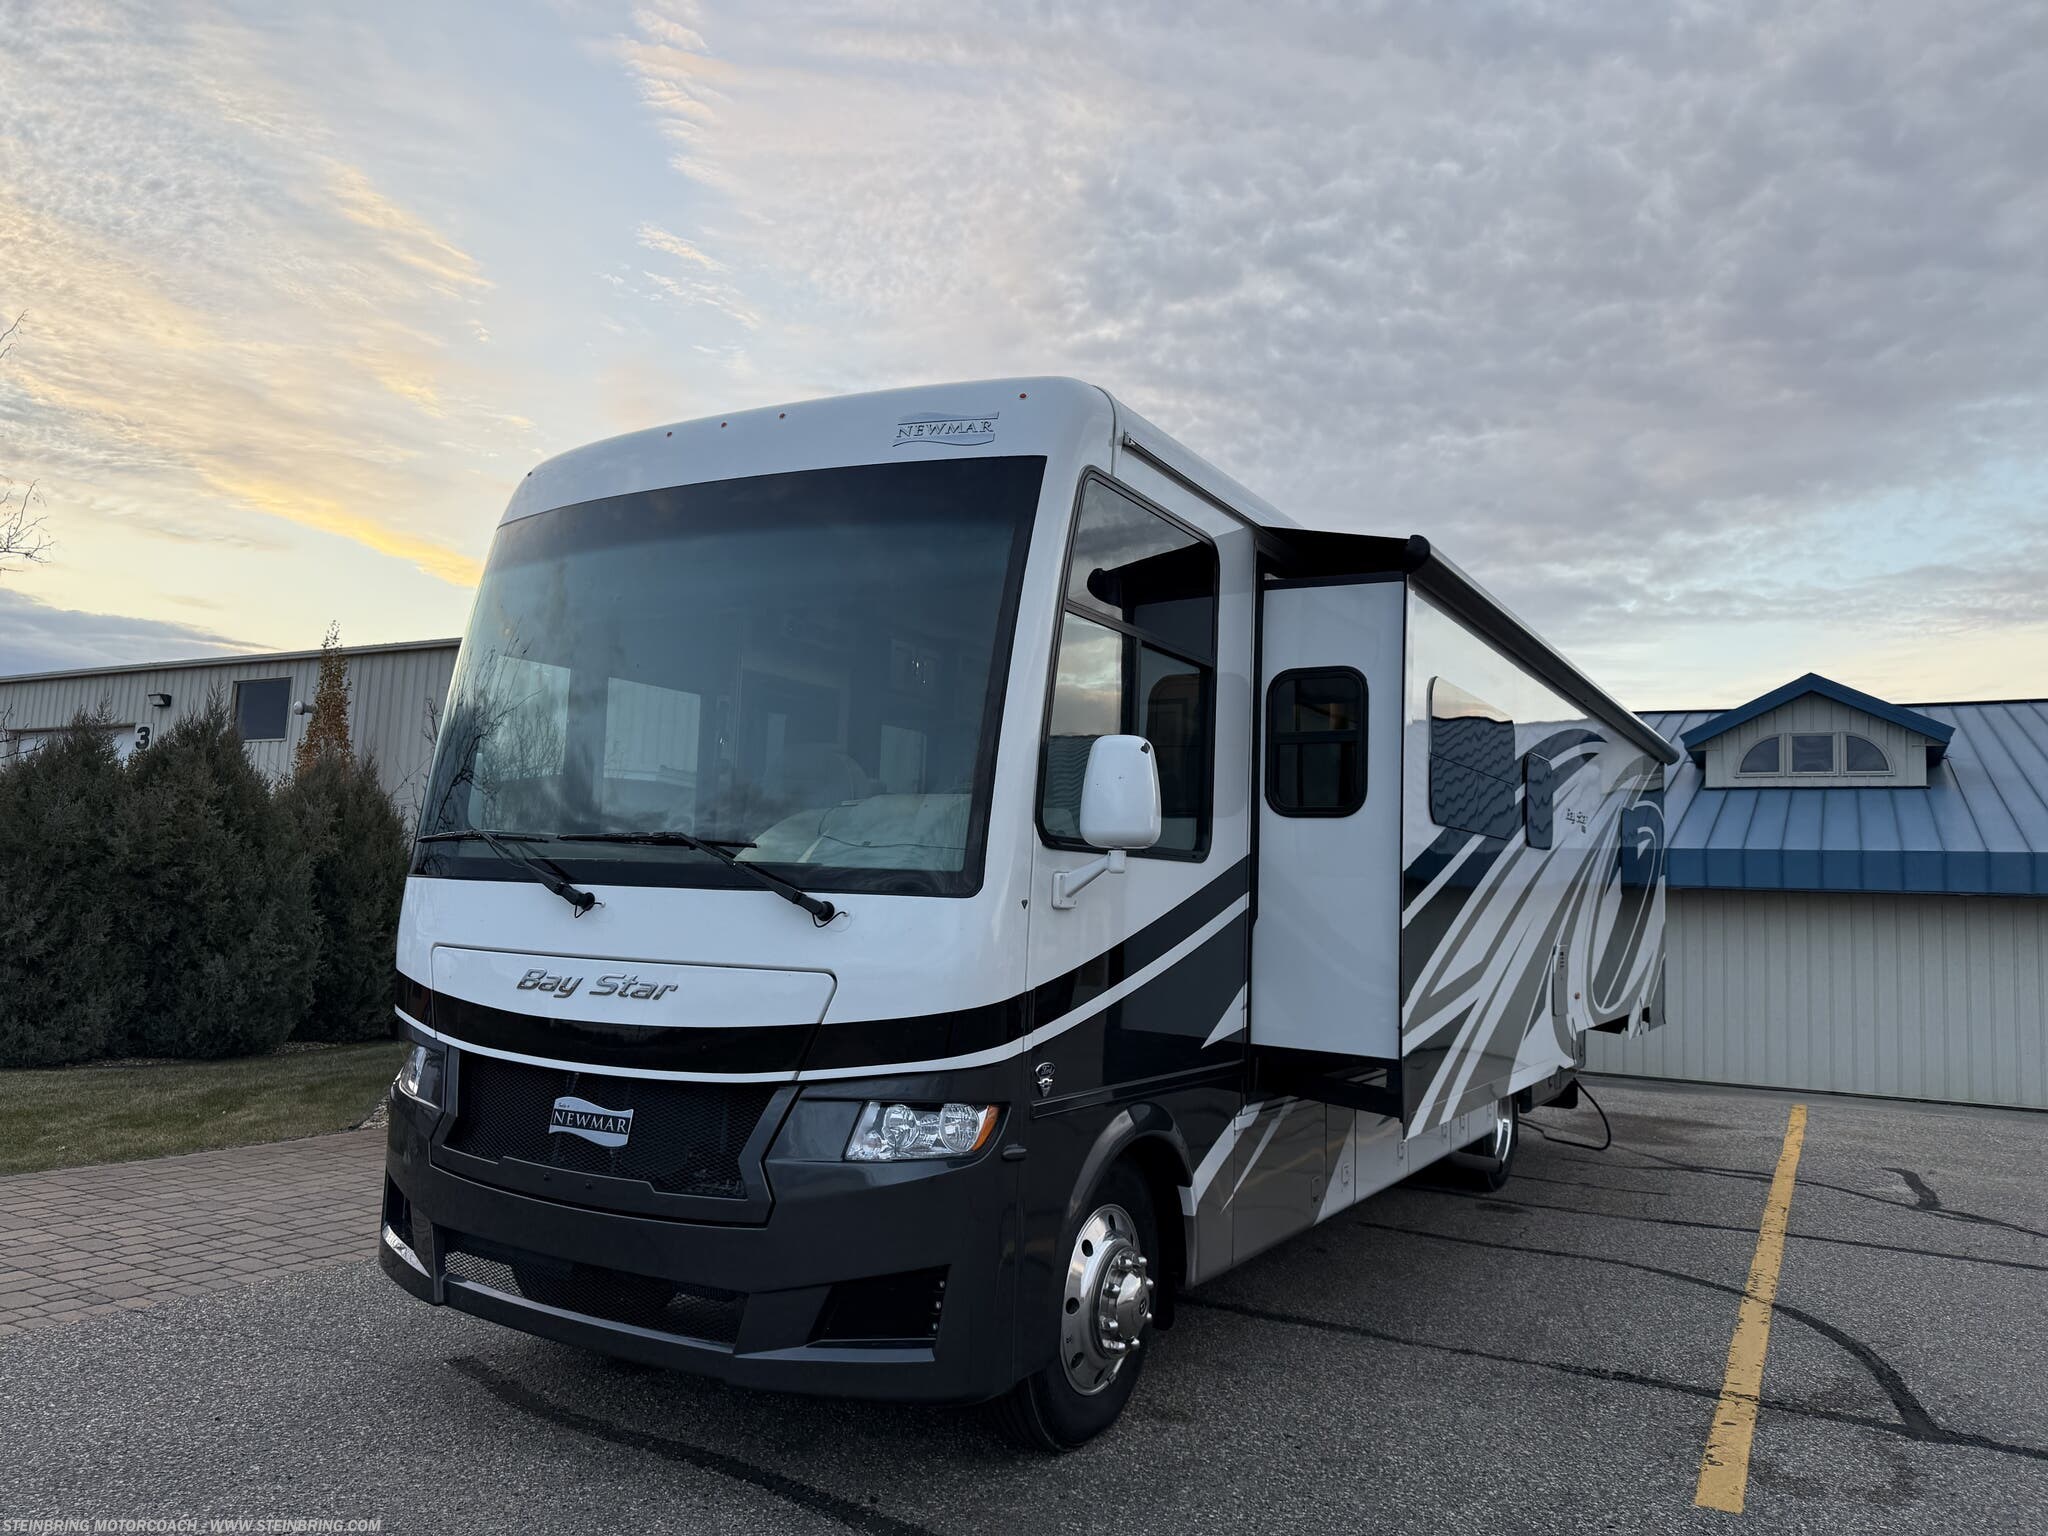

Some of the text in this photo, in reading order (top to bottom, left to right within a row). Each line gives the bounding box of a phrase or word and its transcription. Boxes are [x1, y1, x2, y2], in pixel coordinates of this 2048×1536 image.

[896, 421, 994, 438] NEWMAR
[136, 726, 150, 750] 3
[517, 968, 679, 1000] Bay Star
[553, 1110, 628, 1133] NEWMAR
